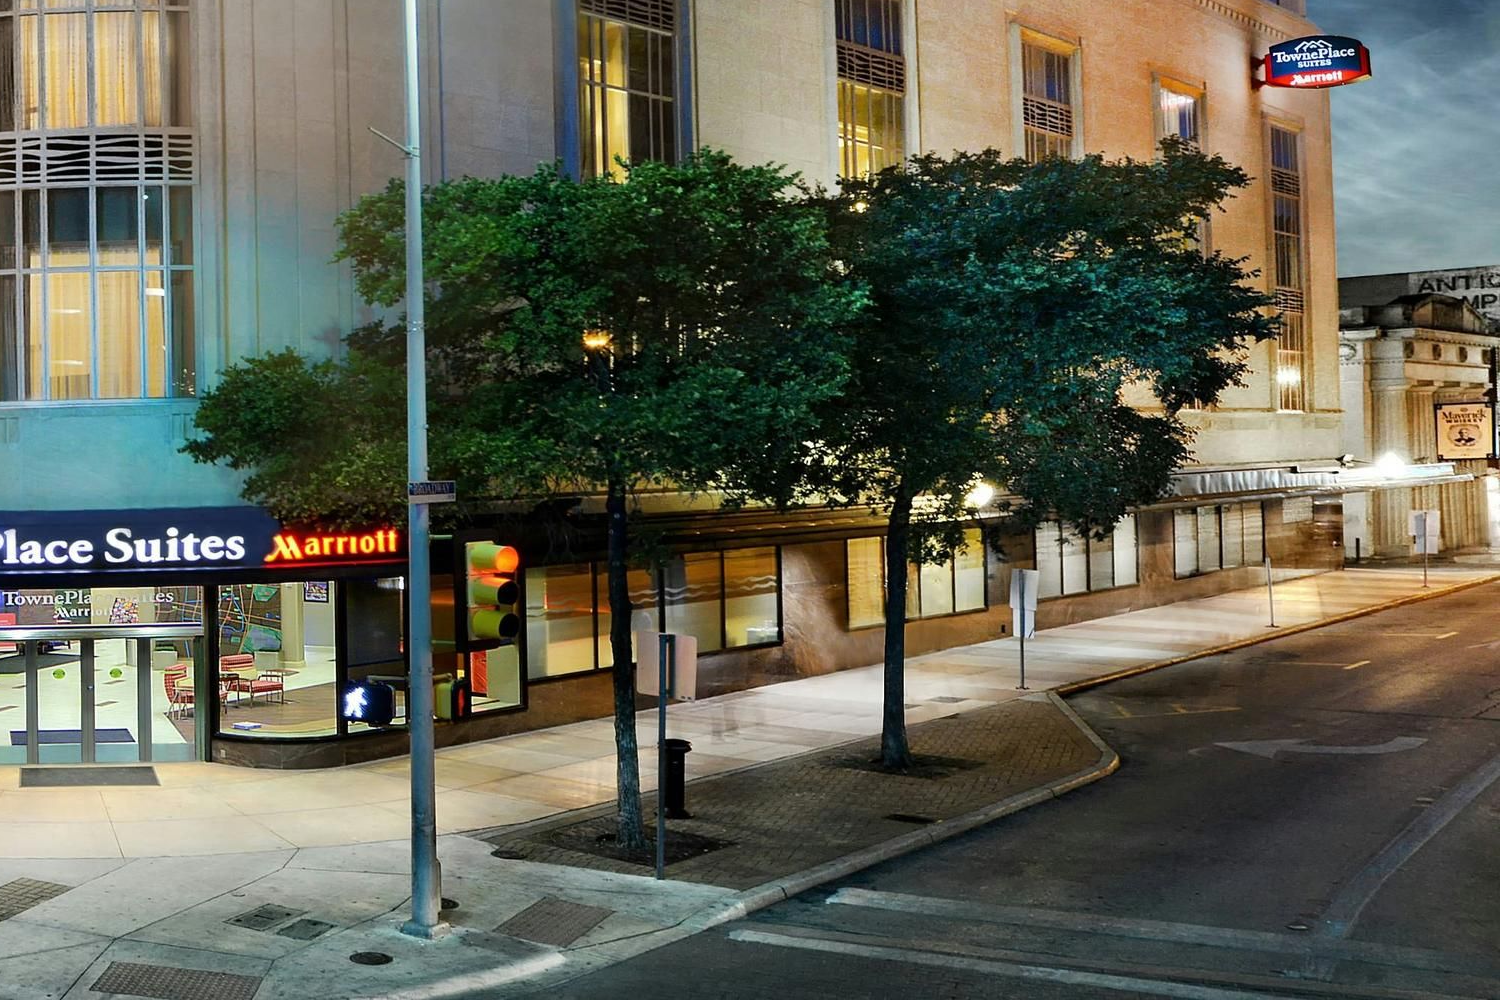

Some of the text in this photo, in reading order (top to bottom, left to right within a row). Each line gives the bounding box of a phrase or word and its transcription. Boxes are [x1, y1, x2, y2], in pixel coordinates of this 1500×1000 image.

[1273, 47, 1355, 63] TownePlace
[1298, 59, 1332, 68] SUITES
[1290, 70, 1343, 85] Marriott
[1442, 408, 1487, 419] Maverick
[104, 527, 245, 563] Suites
[264, 529, 399, 562] Marriott
[2, 590, 113, 606] TownePla
